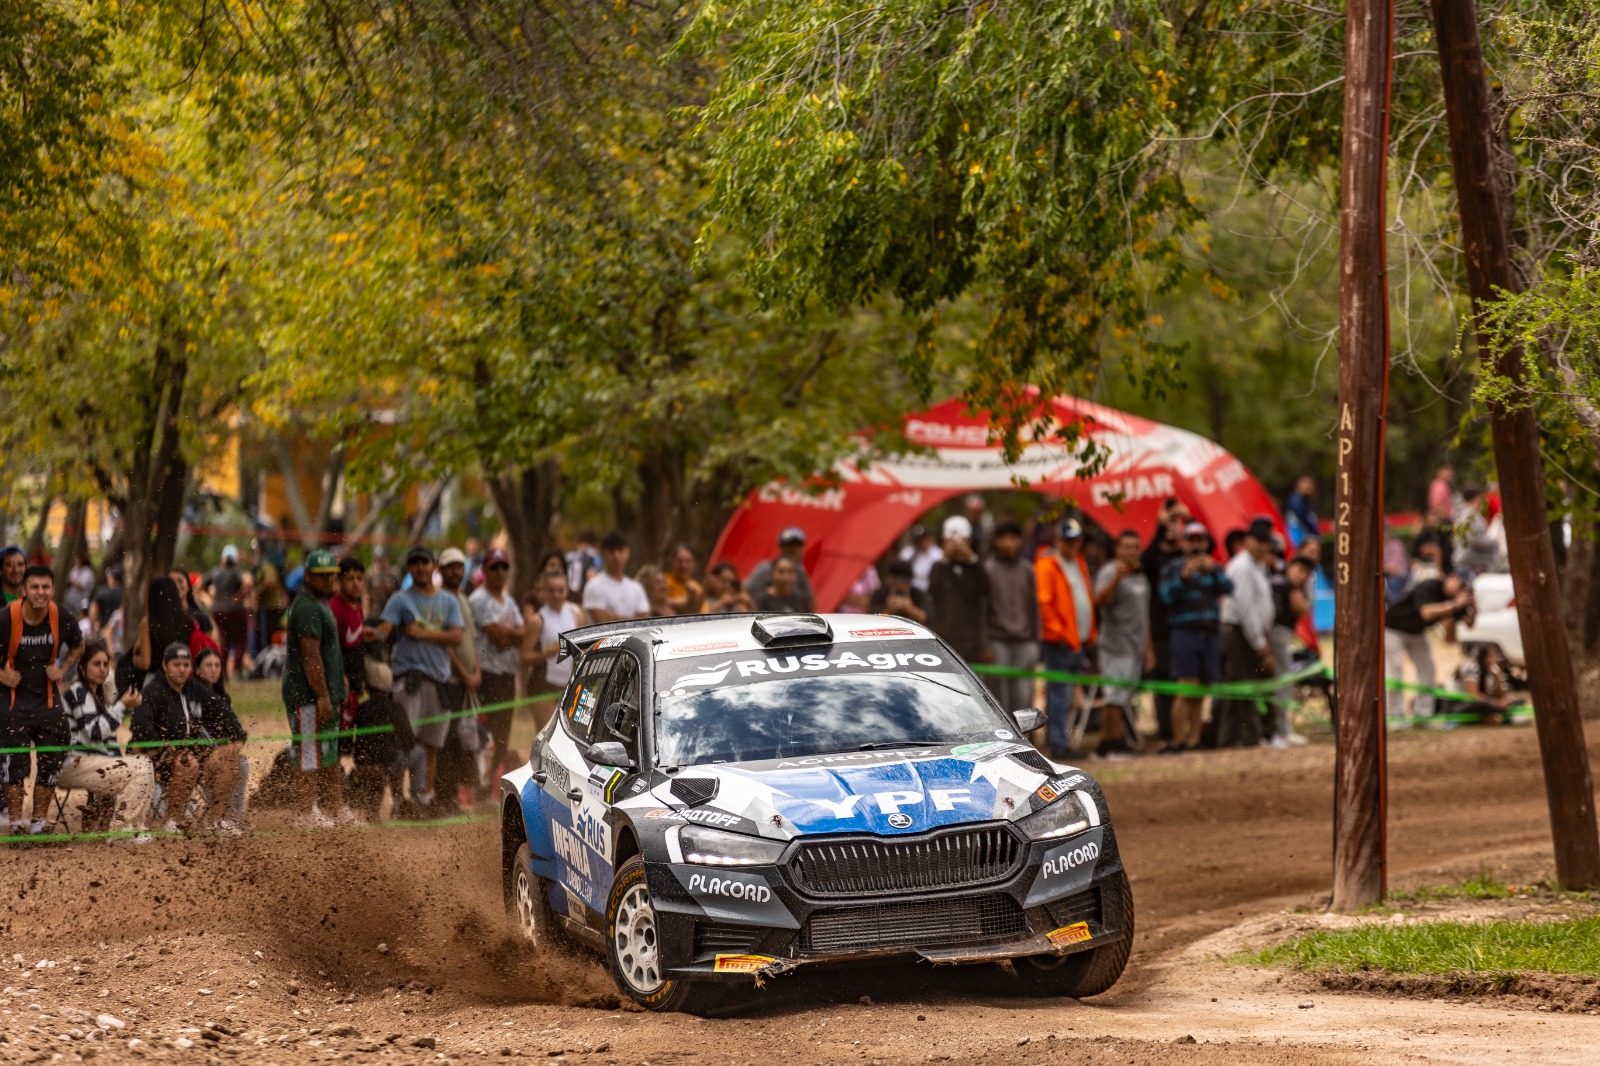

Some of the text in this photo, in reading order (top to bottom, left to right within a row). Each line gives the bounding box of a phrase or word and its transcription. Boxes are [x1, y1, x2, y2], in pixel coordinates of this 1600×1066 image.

[568, 684, 582, 718] 3
[811, 789, 973, 819] YPF
[587, 814, 605, 856] RUS
[1043, 842, 1099, 879] PLACORD
[689, 873, 771, 903] PLACORD
[1051, 925, 1088, 946] PIRELLI
